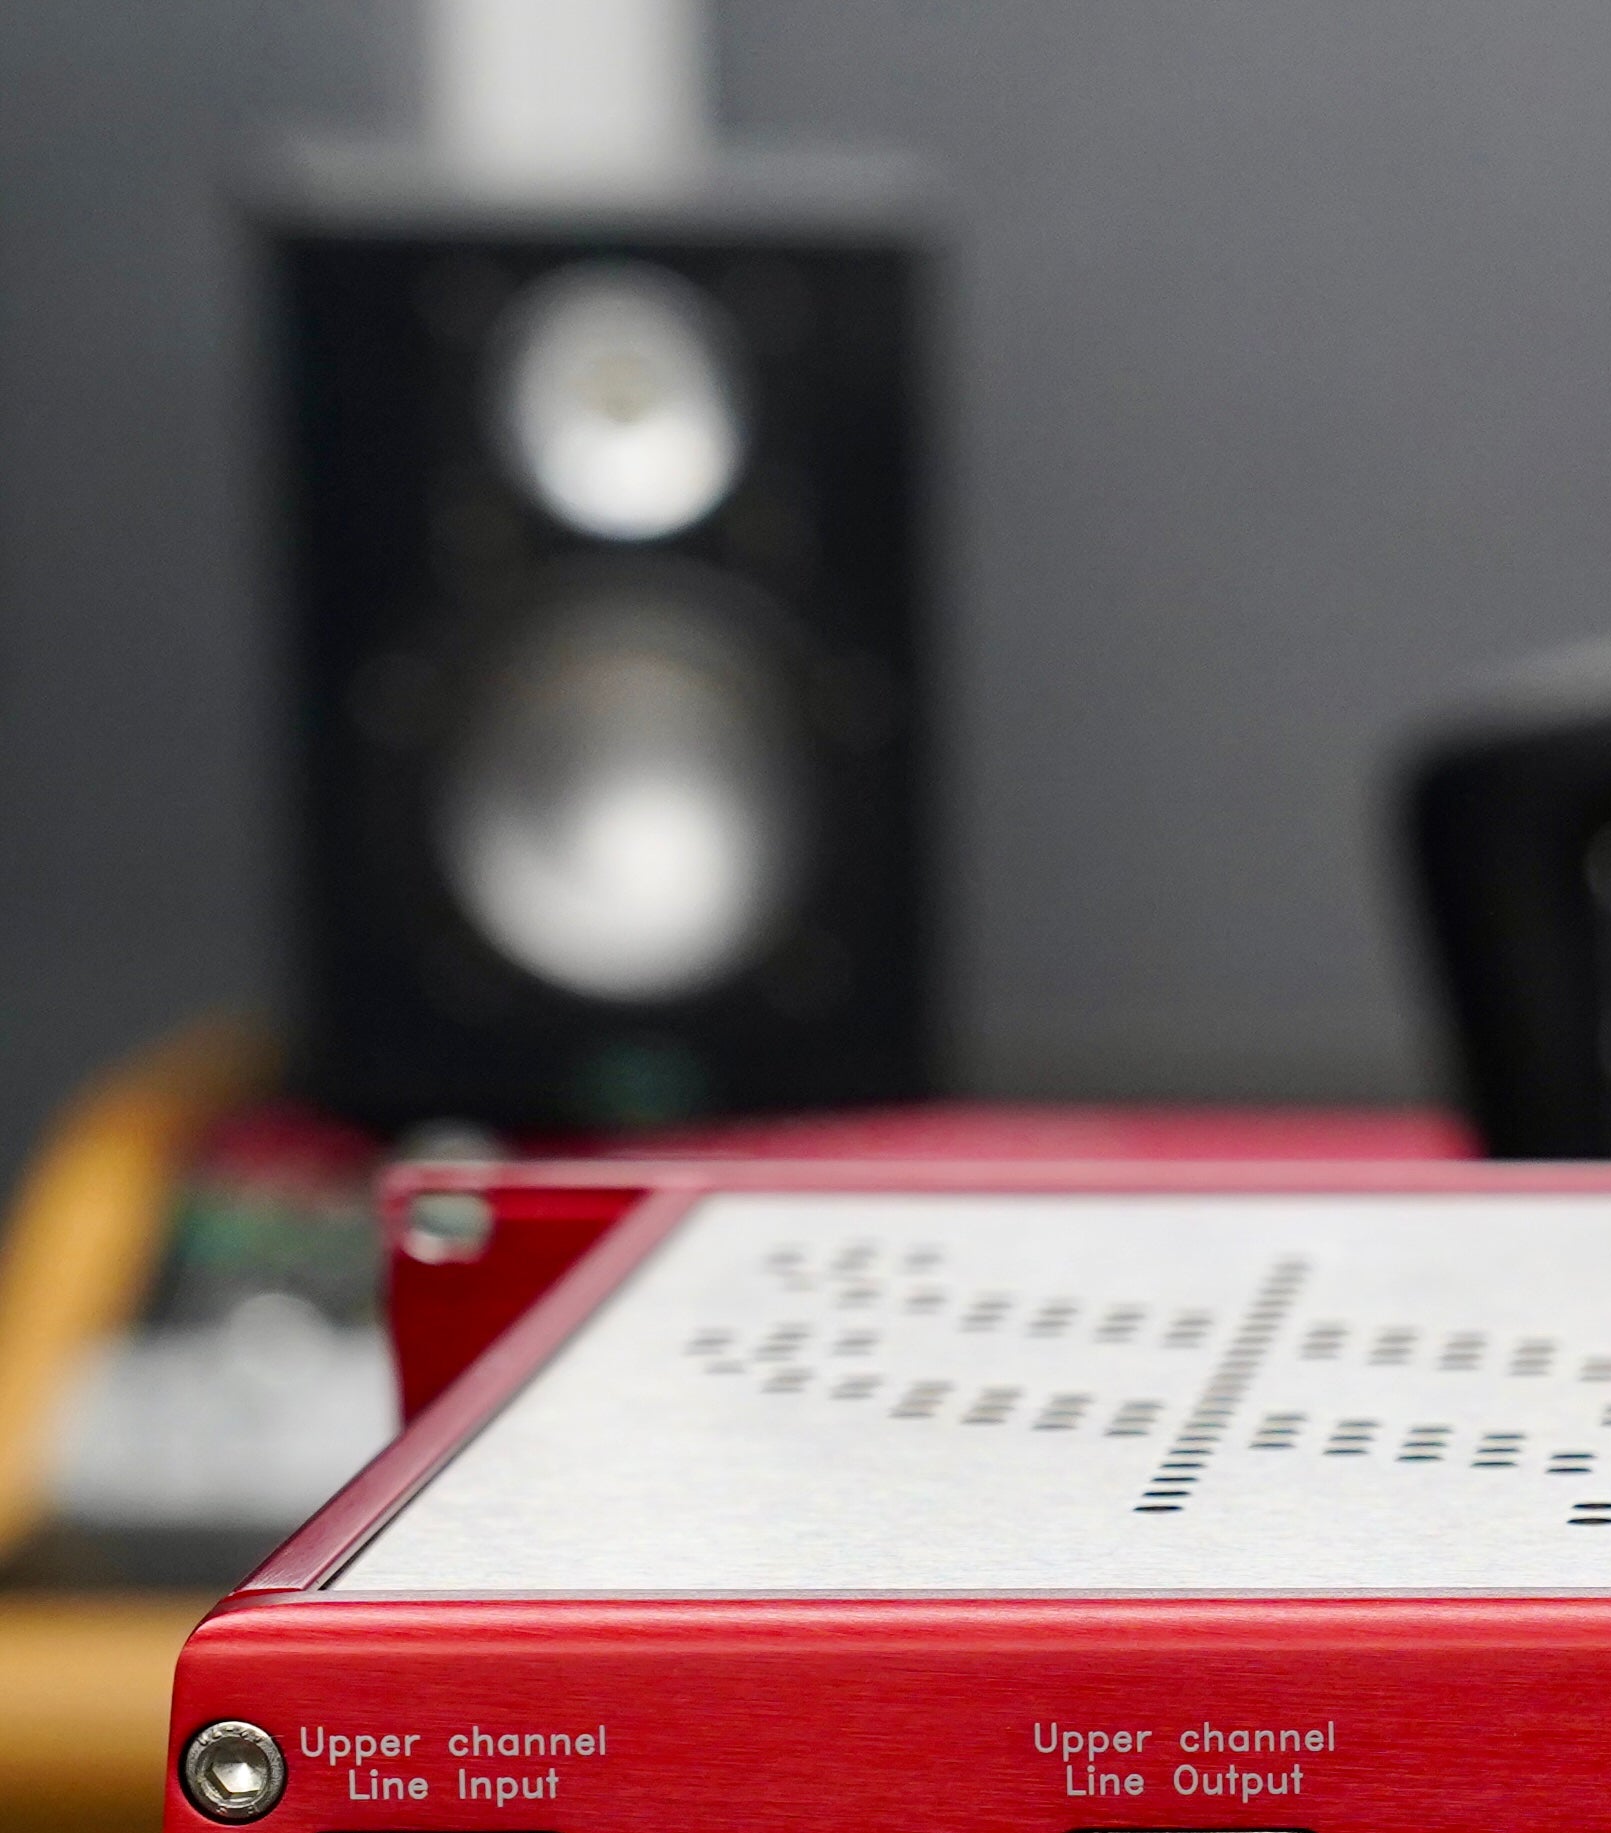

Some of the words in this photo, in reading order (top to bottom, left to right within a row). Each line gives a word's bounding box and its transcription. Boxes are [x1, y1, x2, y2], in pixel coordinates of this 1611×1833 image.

[300, 1726, 421, 1766] Upper
[448, 1724, 606, 1757] channel
[1034, 1722, 1153, 1762] Upper
[1179, 1720, 1335, 1753] channel
[348, 1768, 429, 1800] Line
[458, 1767, 559, 1808] Input
[1066, 1764, 1144, 1796] Line
[1173, 1763, 1304, 1801] Output
